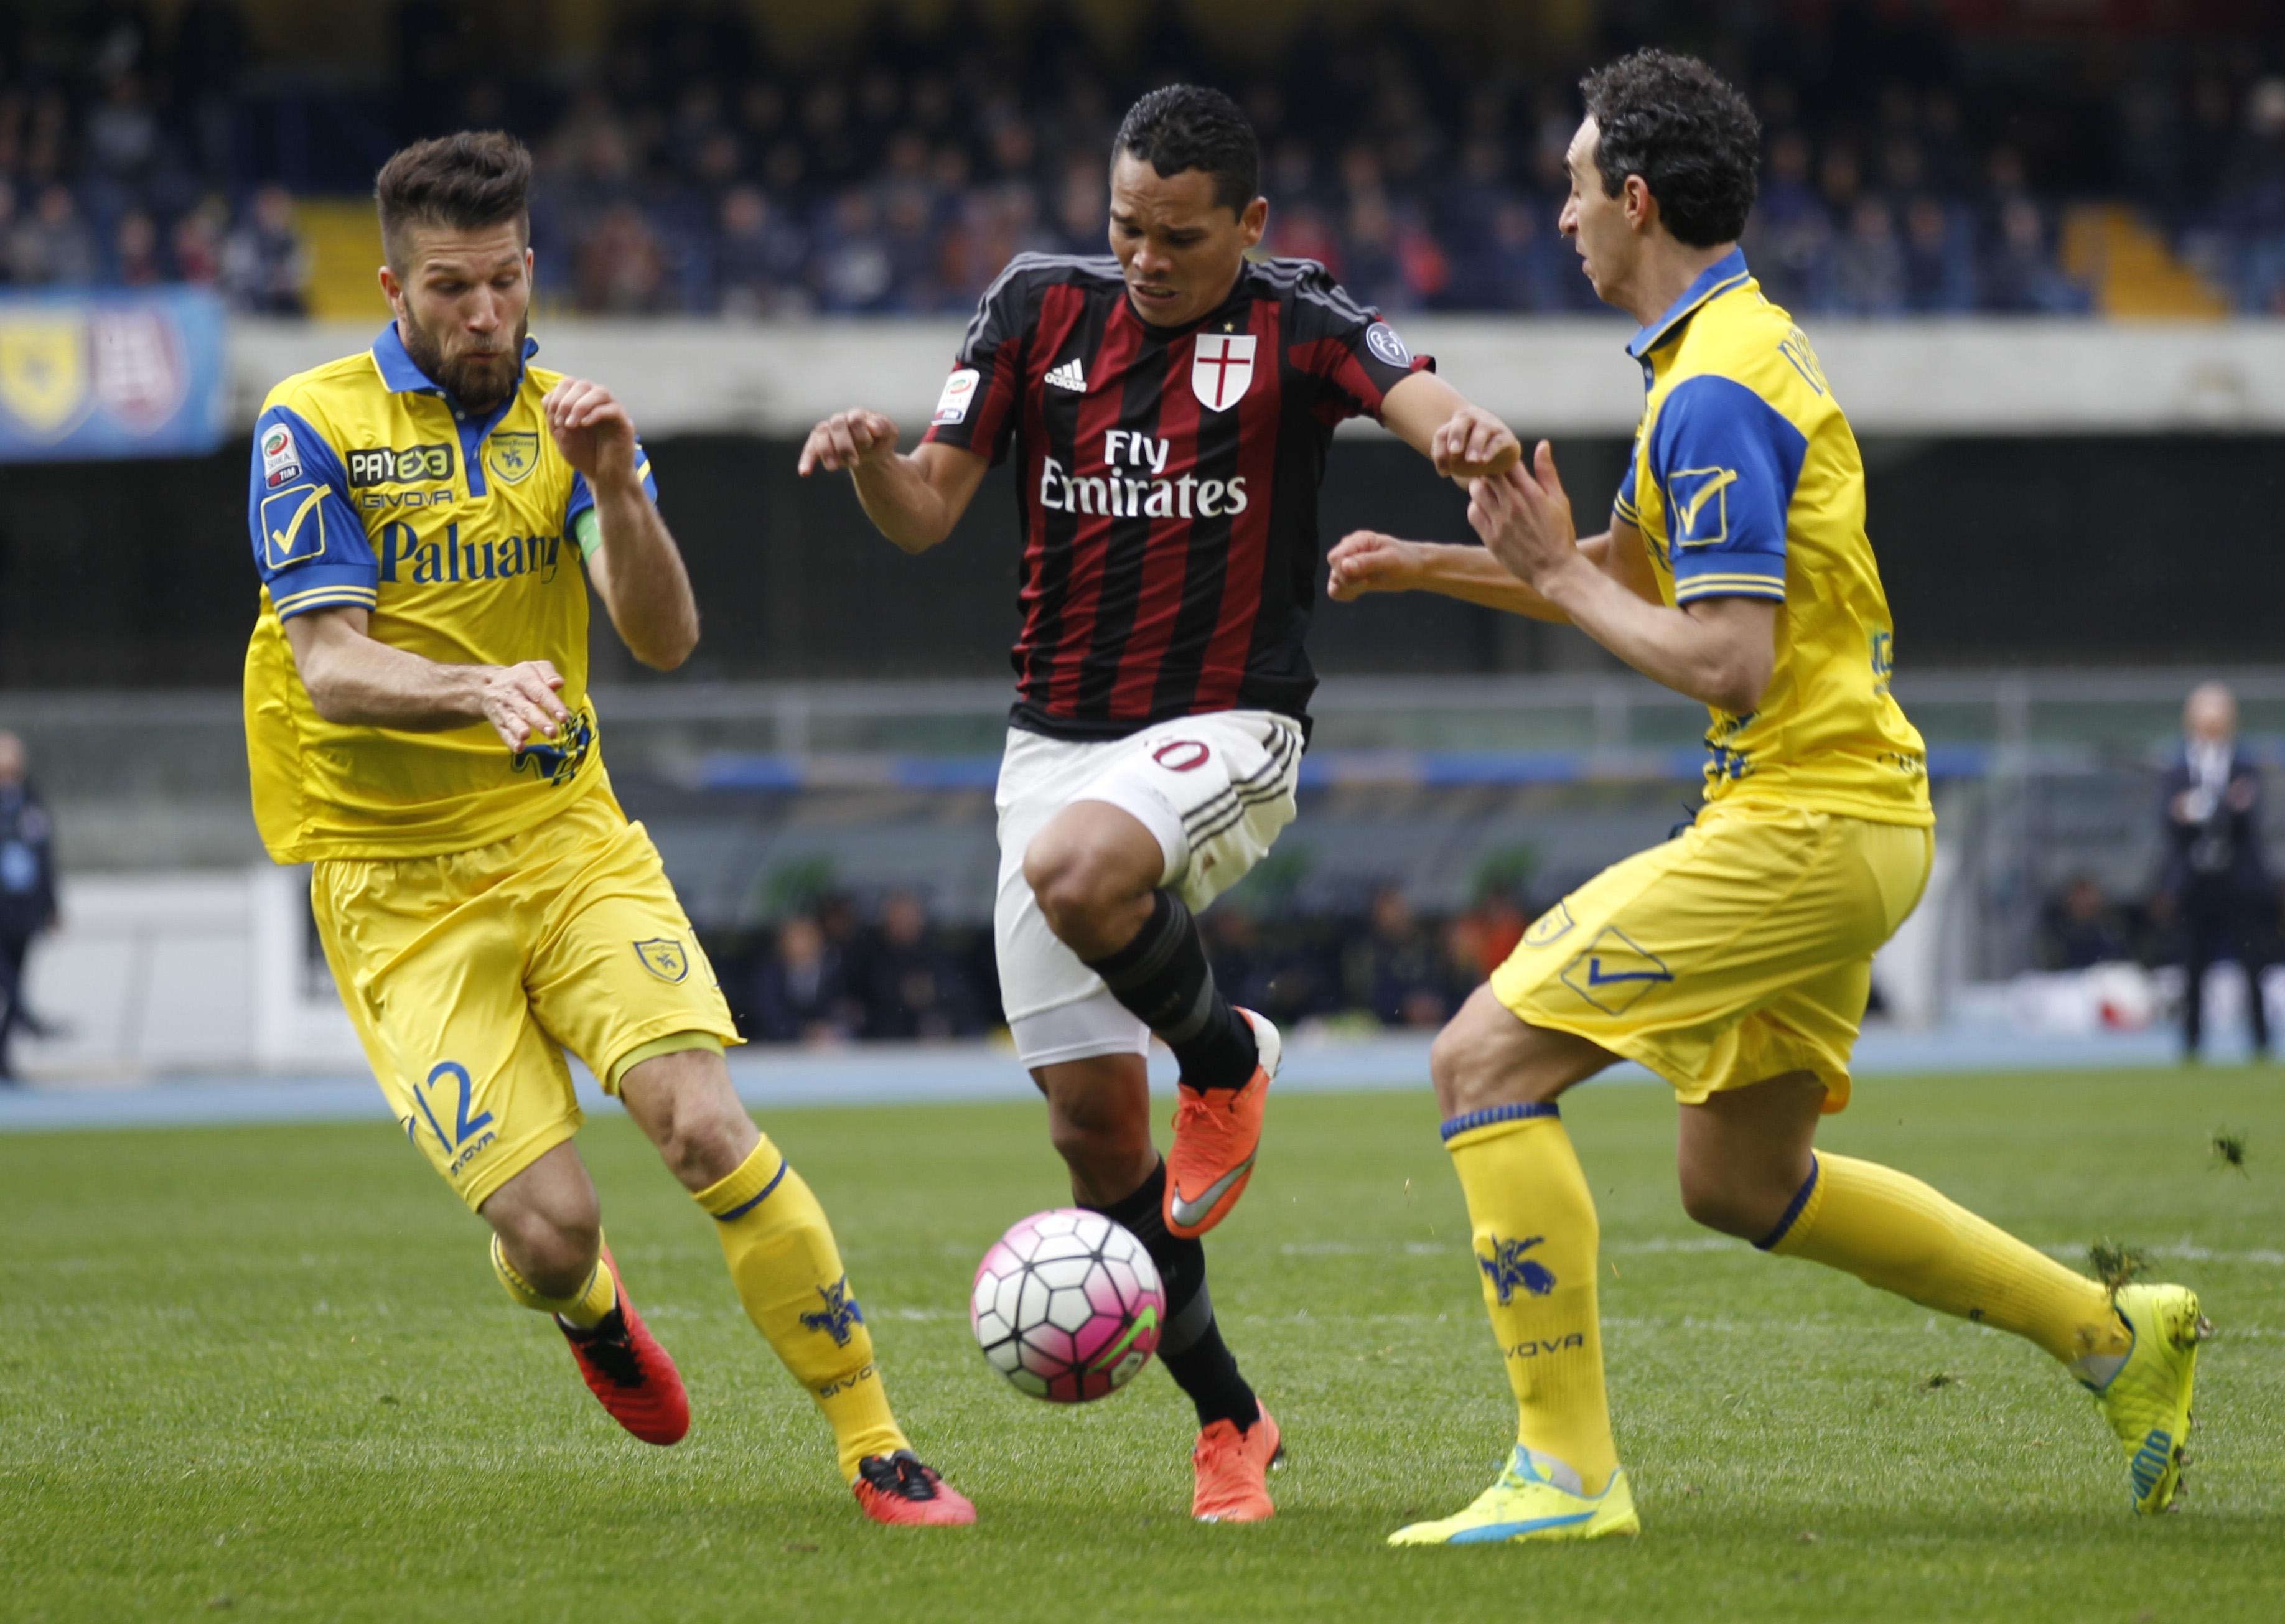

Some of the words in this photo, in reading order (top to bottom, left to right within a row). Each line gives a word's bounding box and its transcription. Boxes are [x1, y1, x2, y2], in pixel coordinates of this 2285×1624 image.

[1044, 372, 1088, 393] adidas
[1104, 429, 1170, 474] Fly
[279, 466, 296, 481] TIM
[1040, 455, 1248, 519] Emirates
[363, 490, 453, 508] GIVOVA
[413, 1061, 494, 1156] 12
